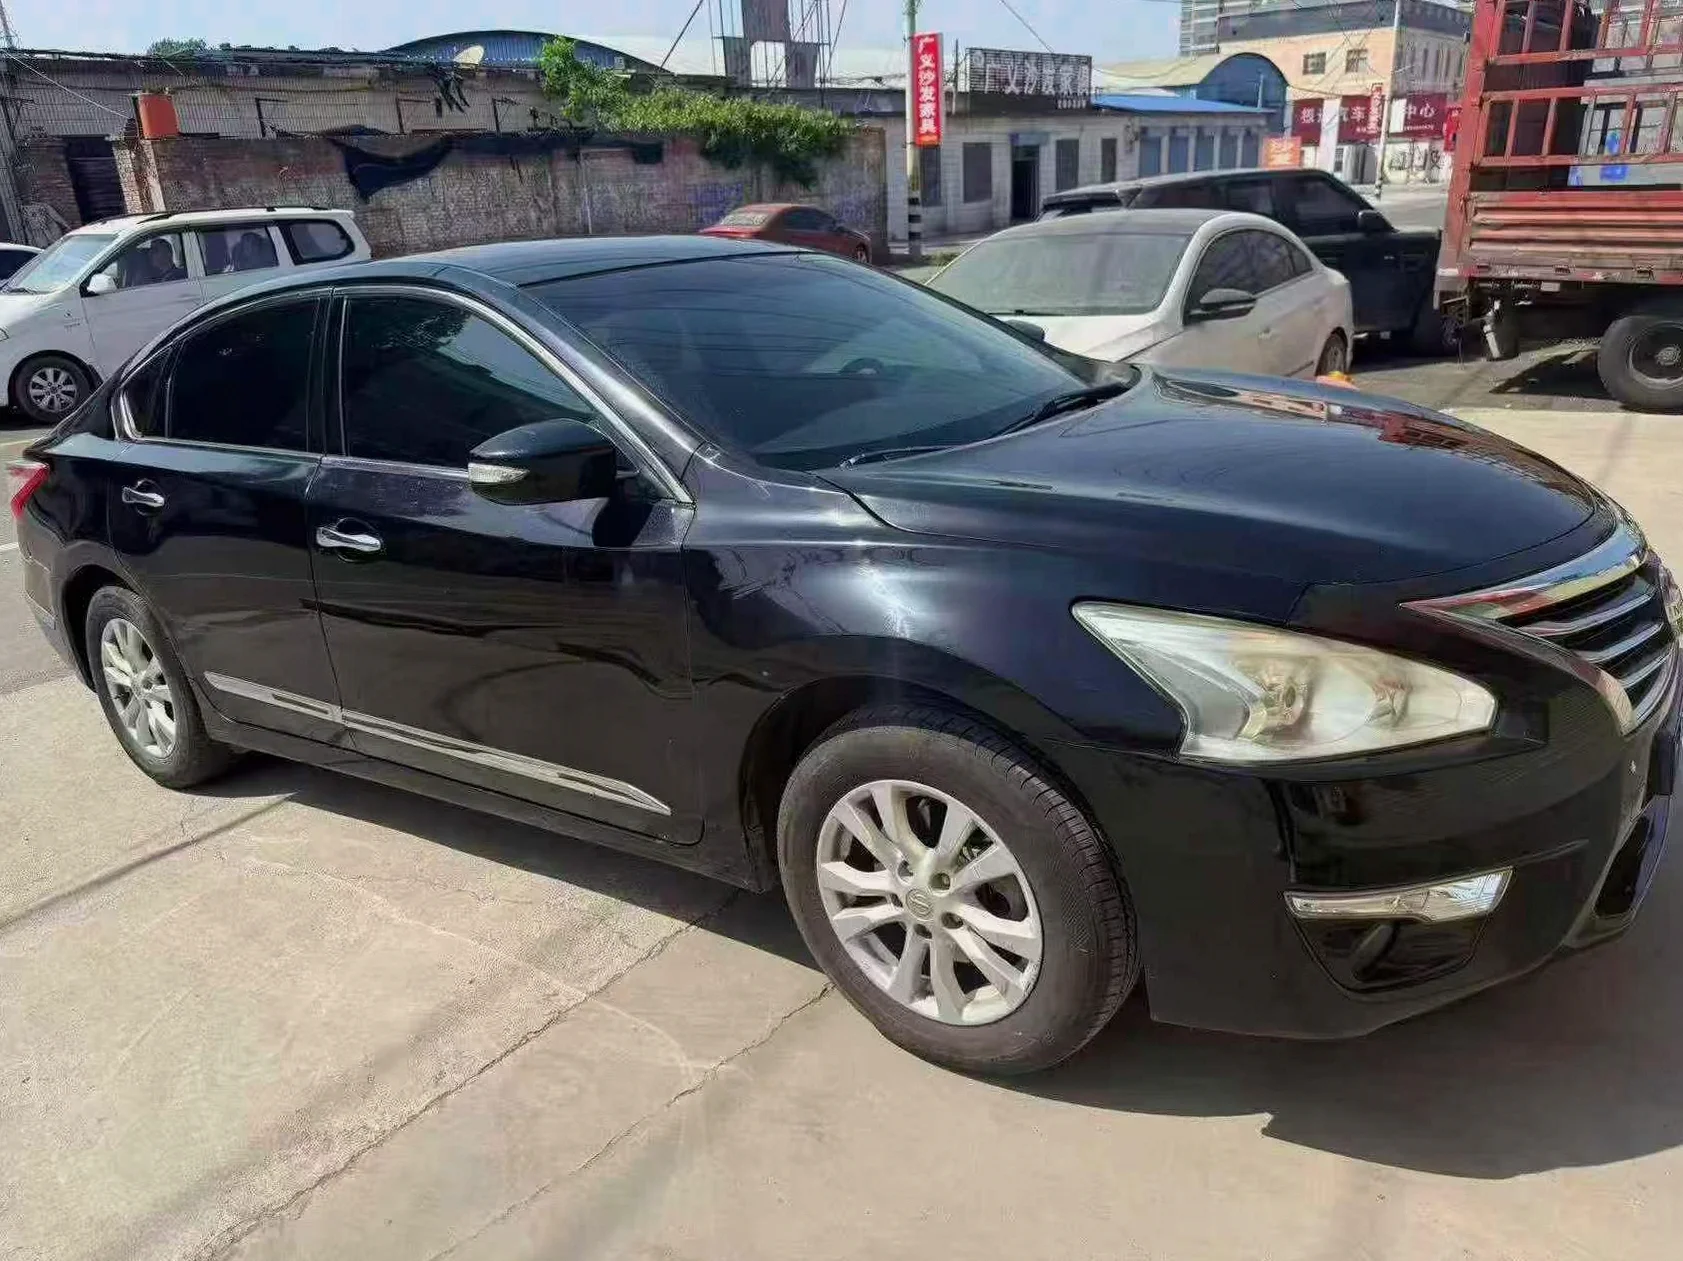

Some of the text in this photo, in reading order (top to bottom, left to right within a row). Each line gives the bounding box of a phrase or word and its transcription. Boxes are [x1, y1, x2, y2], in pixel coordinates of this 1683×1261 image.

[917, 37, 937, 133] 广义沙发家具
